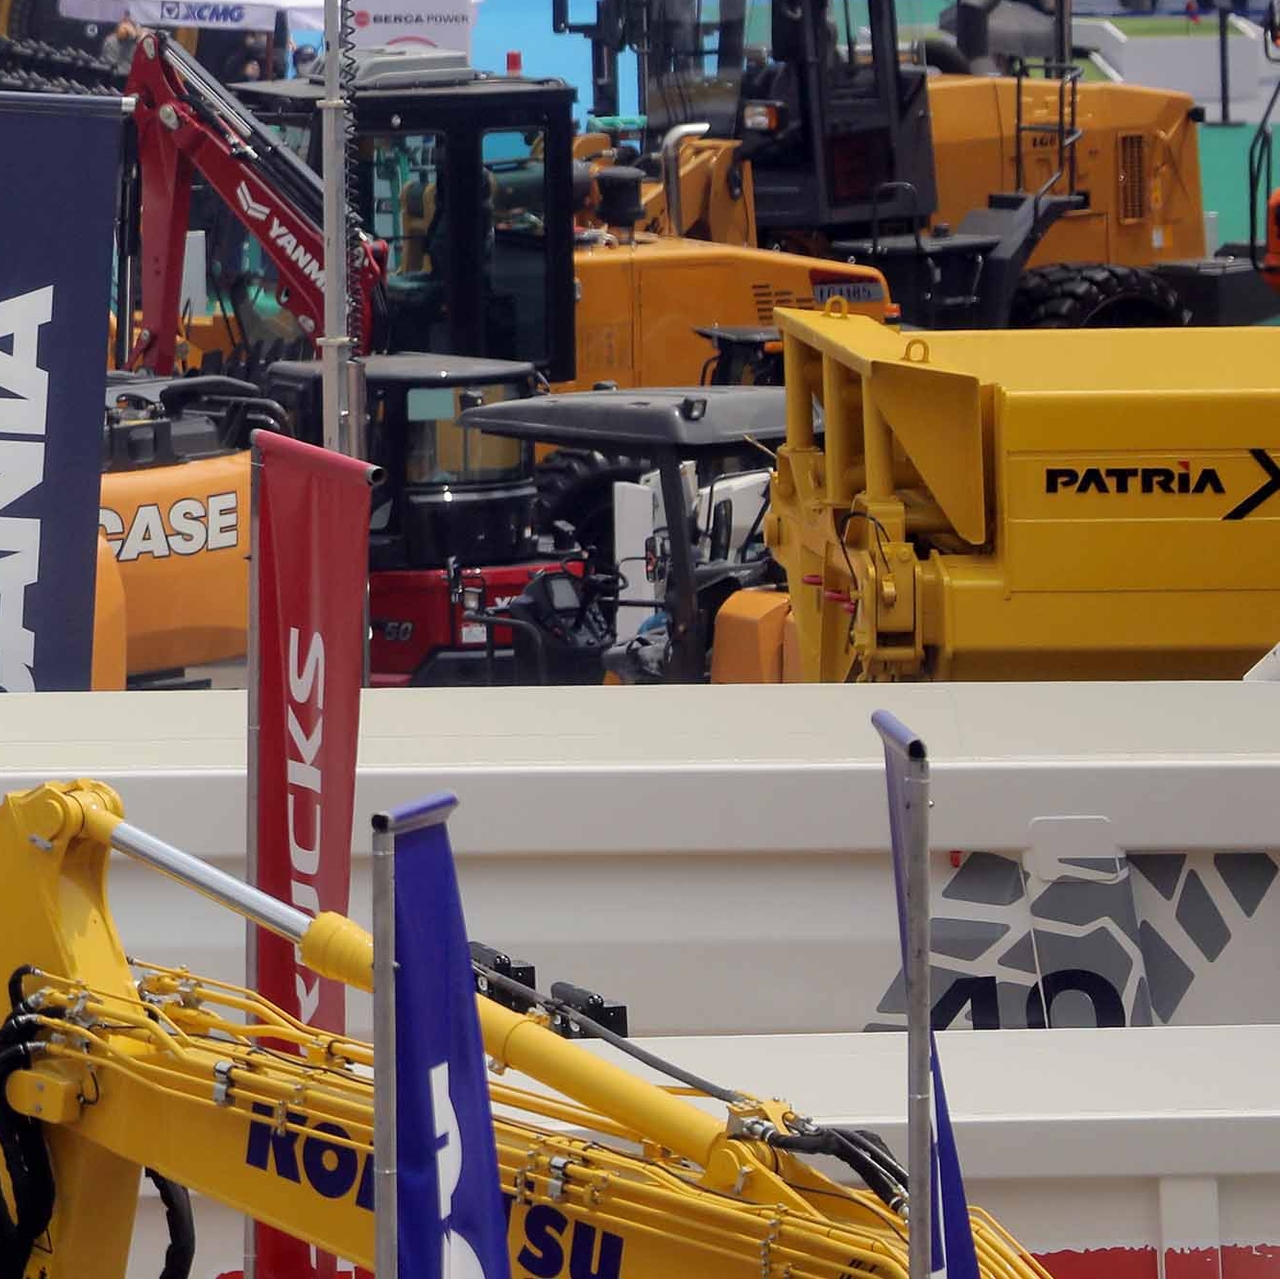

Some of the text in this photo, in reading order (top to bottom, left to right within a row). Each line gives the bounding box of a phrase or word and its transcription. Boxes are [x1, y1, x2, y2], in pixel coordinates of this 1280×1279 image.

[183, 3, 246, 21] XCMG
[269, 217, 326, 293] YANM
[1045, 460, 1226, 494] PATRIA
[246, 1101, 624, 1279] KOSU
